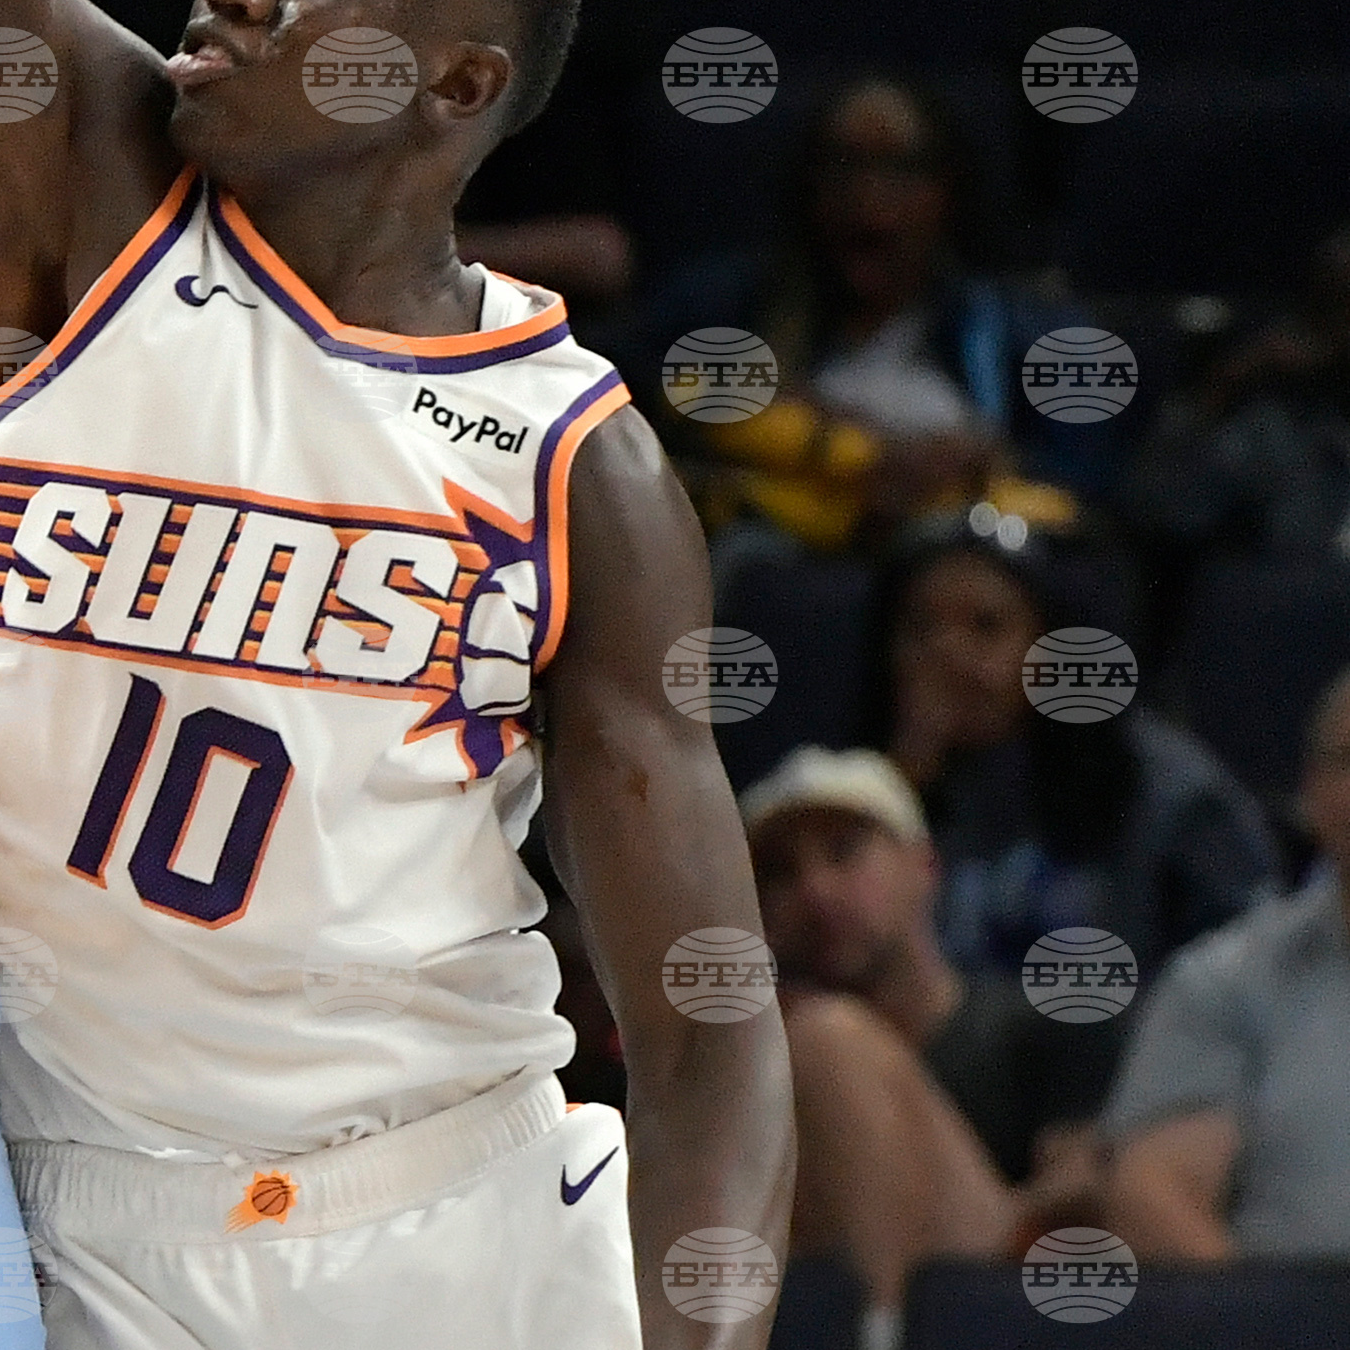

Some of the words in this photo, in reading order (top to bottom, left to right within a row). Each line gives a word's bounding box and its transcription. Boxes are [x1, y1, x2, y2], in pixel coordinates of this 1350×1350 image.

[412, 386, 530, 454] PayPal
[1, 481, 459, 683] SUNS
[66, 673, 295, 931] 10
